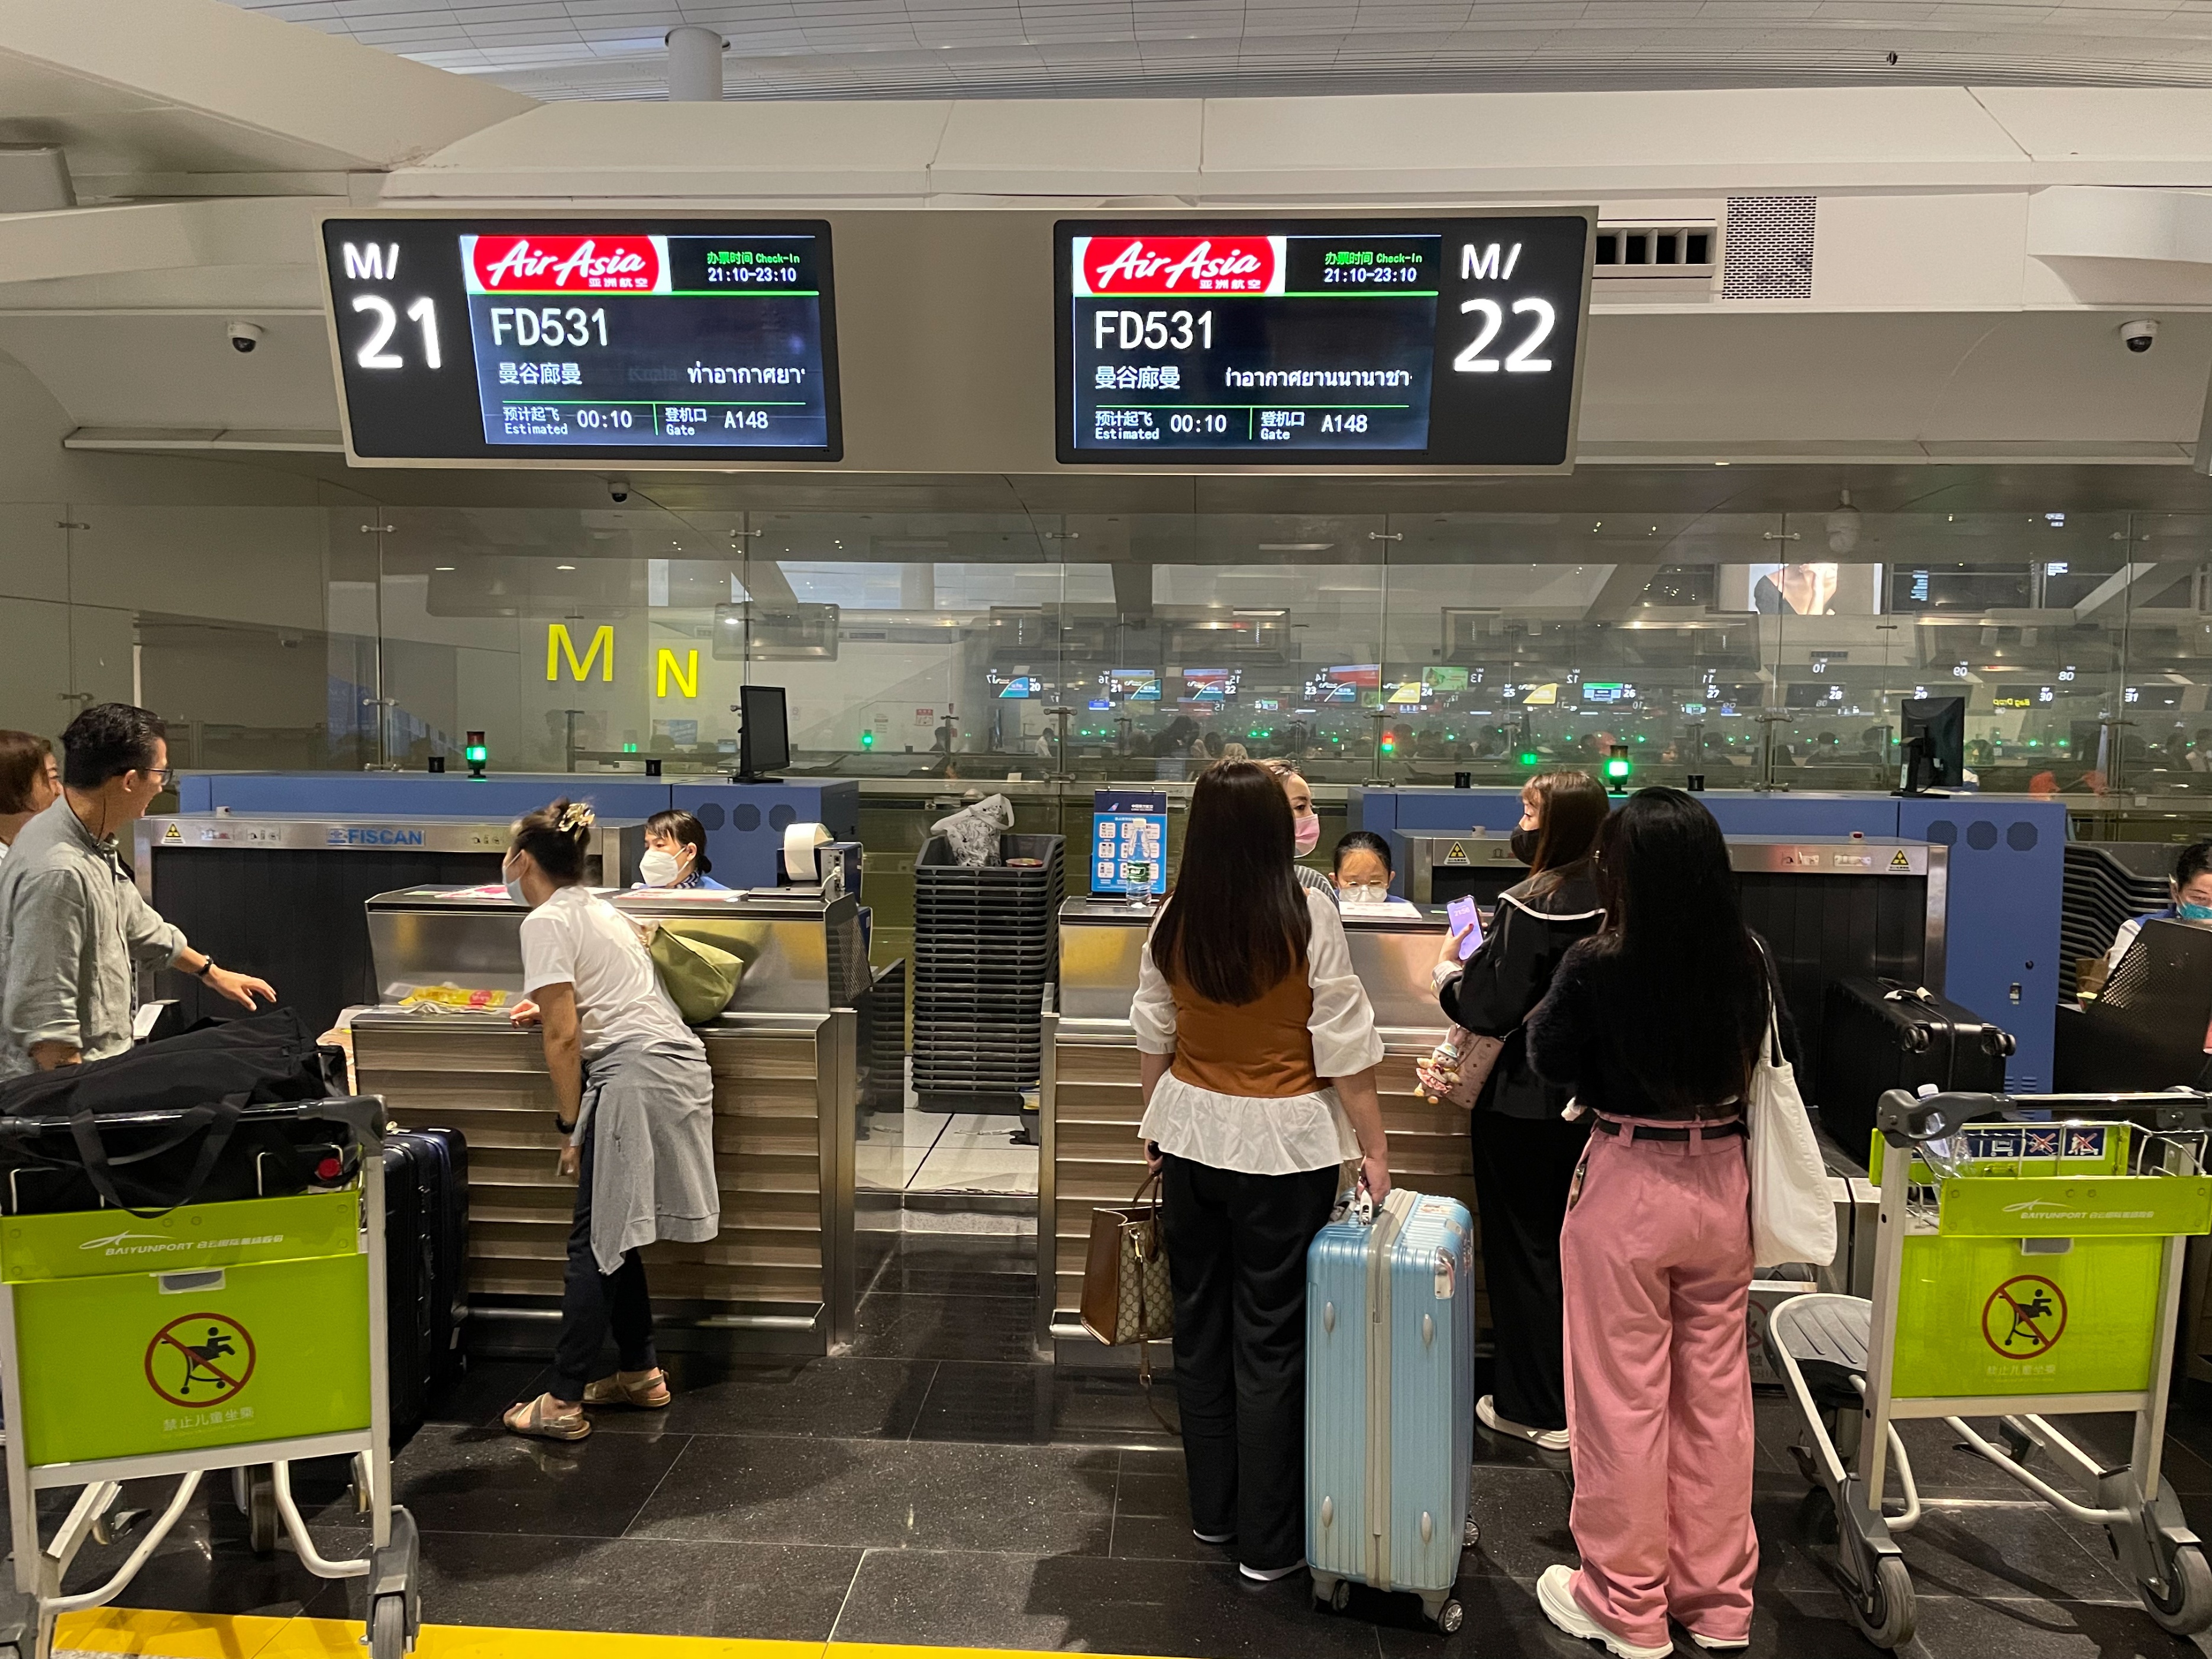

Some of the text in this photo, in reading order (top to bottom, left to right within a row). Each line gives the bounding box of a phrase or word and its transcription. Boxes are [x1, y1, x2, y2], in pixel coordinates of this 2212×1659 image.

[343, 242, 400, 280] M/
[707, 251, 800, 264] 办票时间 Check-In
[1325, 251, 1423, 265] 办票时间 Check-In
[1461, 242, 1522, 280] M/
[588, 277, 648, 288] 亚洲航空
[708, 267, 797, 282] 21:10-23:10
[1324, 267, 1417, 283] 21:10-23:10
[1199, 279, 1261, 289] 亚洲航空
[352, 296, 442, 369] 21
[490, 307, 608, 347] FD531
[1095, 310, 1212, 350] FD531
[1454, 298, 1556, 372] 22
[499, 362, 583, 385] 曼谷廊曼
[687, 360, 806, 384] ท่าอากาศยา
[1094, 365, 1181, 390] 曼谷廊曼
[1226, 366, 1413, 386] ่าอากาศยานนานาชา
[503, 406, 560, 422] 预计起飞
[576, 409, 632, 428] 00:10
[665, 407, 707, 422] 登机口
[724, 411, 768, 429] A148
[1095, 411, 1153, 427] 预计起飞
[1261, 411, 1305, 427] 登机口
[505, 422, 569, 435] Estimated
[666, 424, 696, 436] Gate
[1170, 414, 1227, 432] 00:10
[1320, 414, 1368, 432] A148
[1095, 428, 1160, 440] Estimated
[1261, 428, 1290, 440] Gate
[547, 624, 613, 681] M
[657, 648, 699, 698] N
[1029, 683, 1041, 692] 20
[1110, 683, 1123, 693] 21
[1225, 685, 1237, 694] 22
[1304, 686, 1317, 695] 23
[1421, 688, 1433, 697] 24
[1623, 689, 1636, 698] 26
[1707, 689, 1720, 699] 27
[1829, 690, 1843, 700] 28
[2039, 692, 2053, 702] 30
[348, 829, 422, 845] FISCAN
[105, 1242, 195, 1255] BAIYUNPORT
